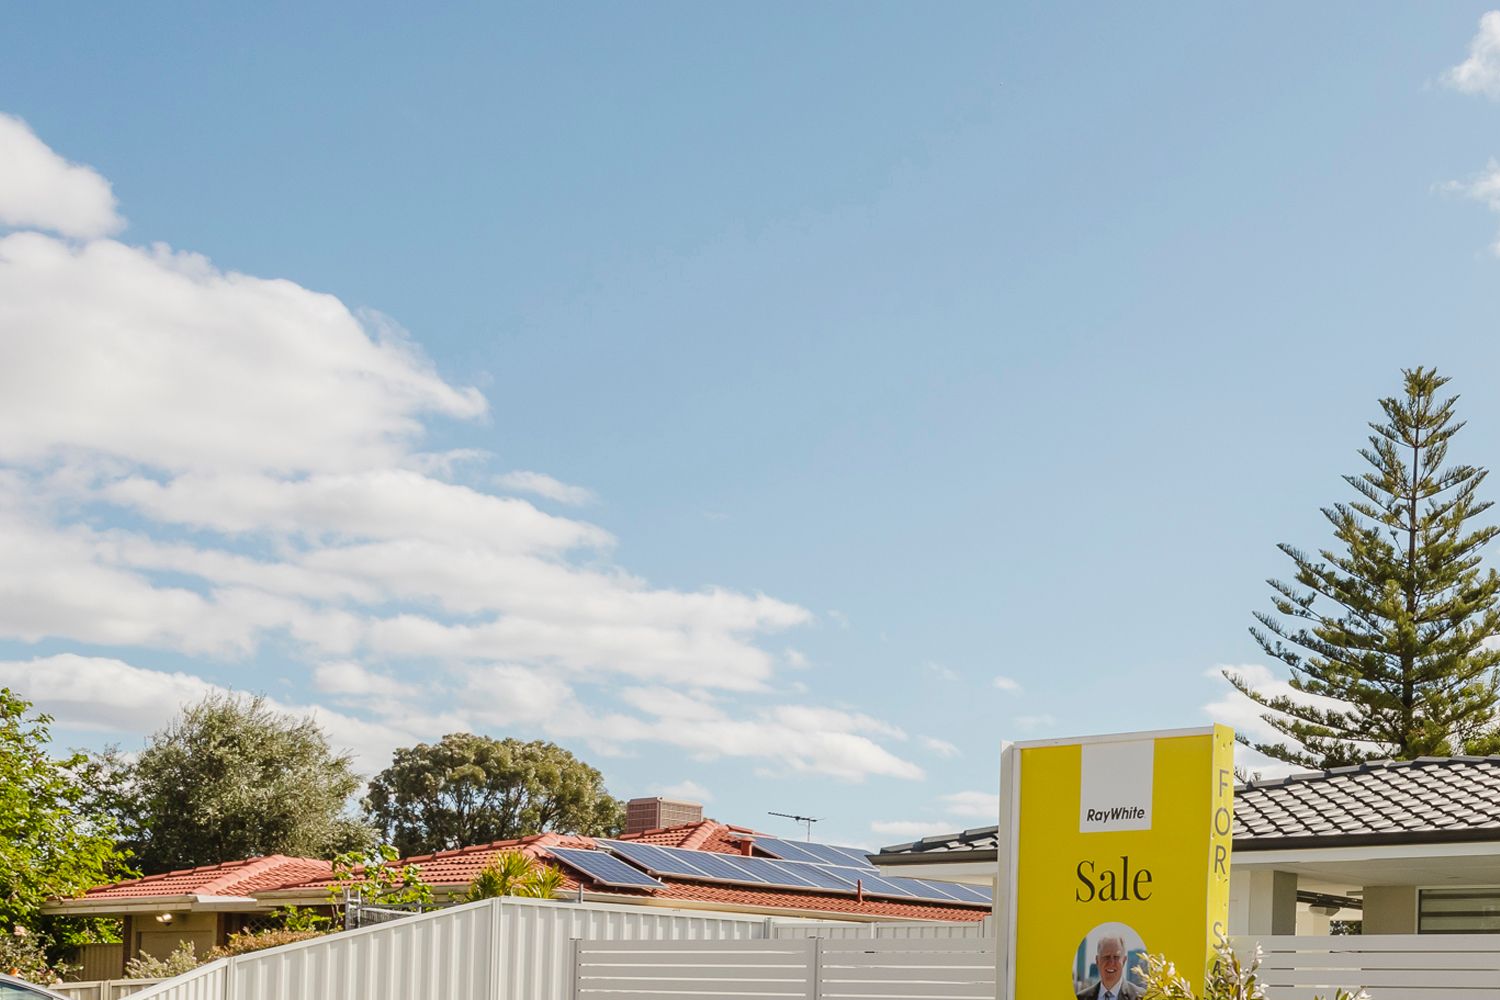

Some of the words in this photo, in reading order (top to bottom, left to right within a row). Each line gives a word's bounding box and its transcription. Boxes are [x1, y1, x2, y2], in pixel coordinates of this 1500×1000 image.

[1086, 806, 1145, 823] RayWhite
[1214, 769, 1231, 875] FOR
[1075, 855, 1153, 903] Sale
